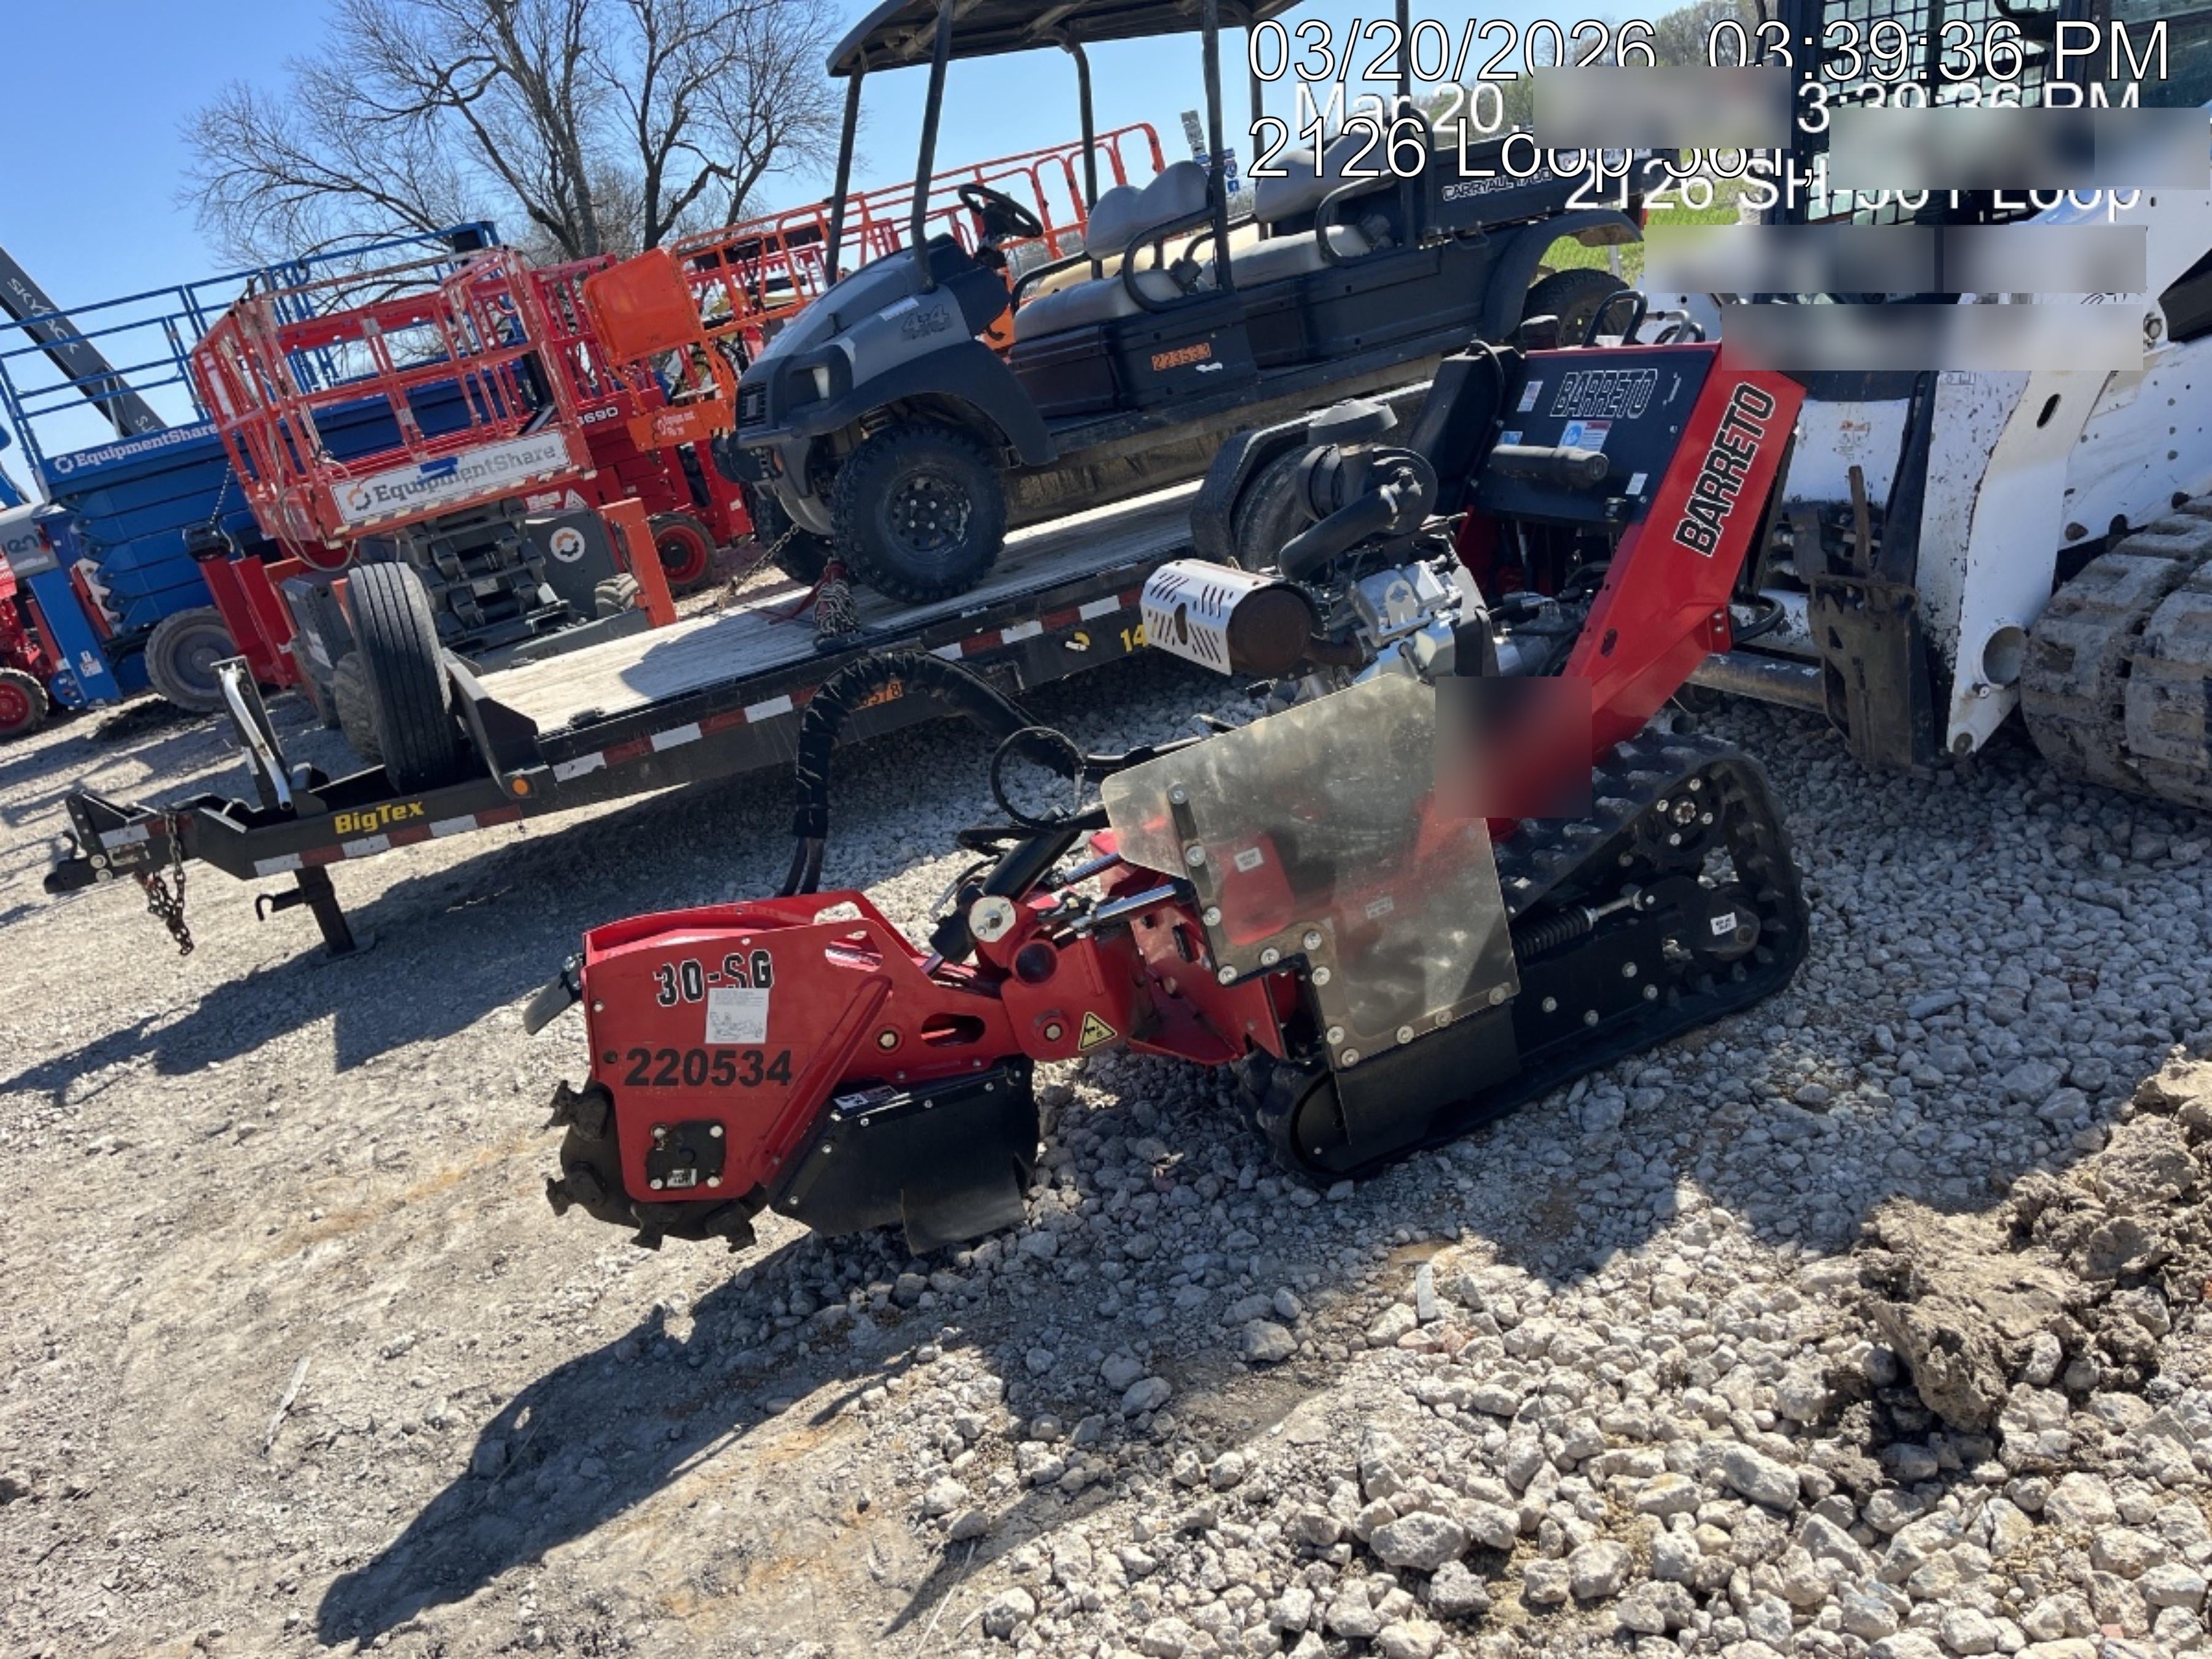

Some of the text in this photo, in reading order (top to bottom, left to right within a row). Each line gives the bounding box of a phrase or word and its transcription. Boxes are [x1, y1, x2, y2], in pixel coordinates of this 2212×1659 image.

[1442, 176, 1514, 202] CARRYALL
[1549, 368, 1658, 419] BARRETO
[74, 423, 218, 468] EquipmentShare
[1672, 382, 1775, 557] BARRETO
[372, 444, 556, 503] EquipmentShare
[334, 800, 425, 834] BigTex
[653, 949, 774, 1007] 30-SG
[624, 1048, 793, 1088] 220534
